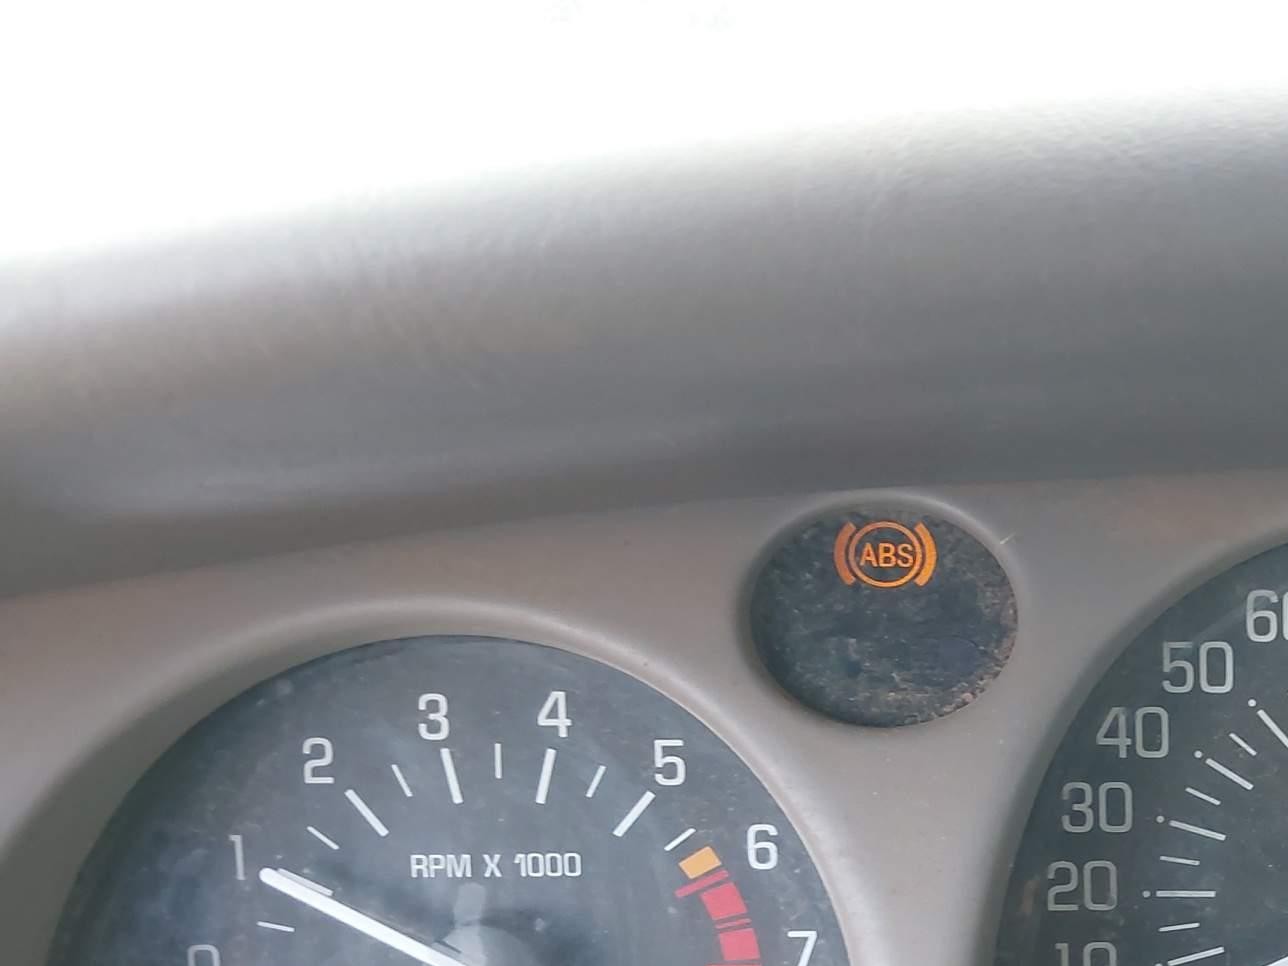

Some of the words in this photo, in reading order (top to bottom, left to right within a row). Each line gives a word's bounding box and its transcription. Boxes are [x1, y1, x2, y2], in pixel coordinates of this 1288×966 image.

[860, 542, 914, 567] ABS
[1162, 641, 1234, 694] 50
[418, 693, 450, 741] 3
[537, 690, 572, 738] 4
[1096, 706, 1169, 759] 40
[302, 737, 335, 784] 2
[653, 739, 686, 786] 5
[1061, 781, 1133, 833] 30
[229, 834, 247, 881] 1
[410, 853, 472, 878] RPM
[482, 853, 502, 878] X
[513, 852, 582, 877] 1000
[746, 823, 778, 870] 6
[1047, 860, 1118, 911] 20
